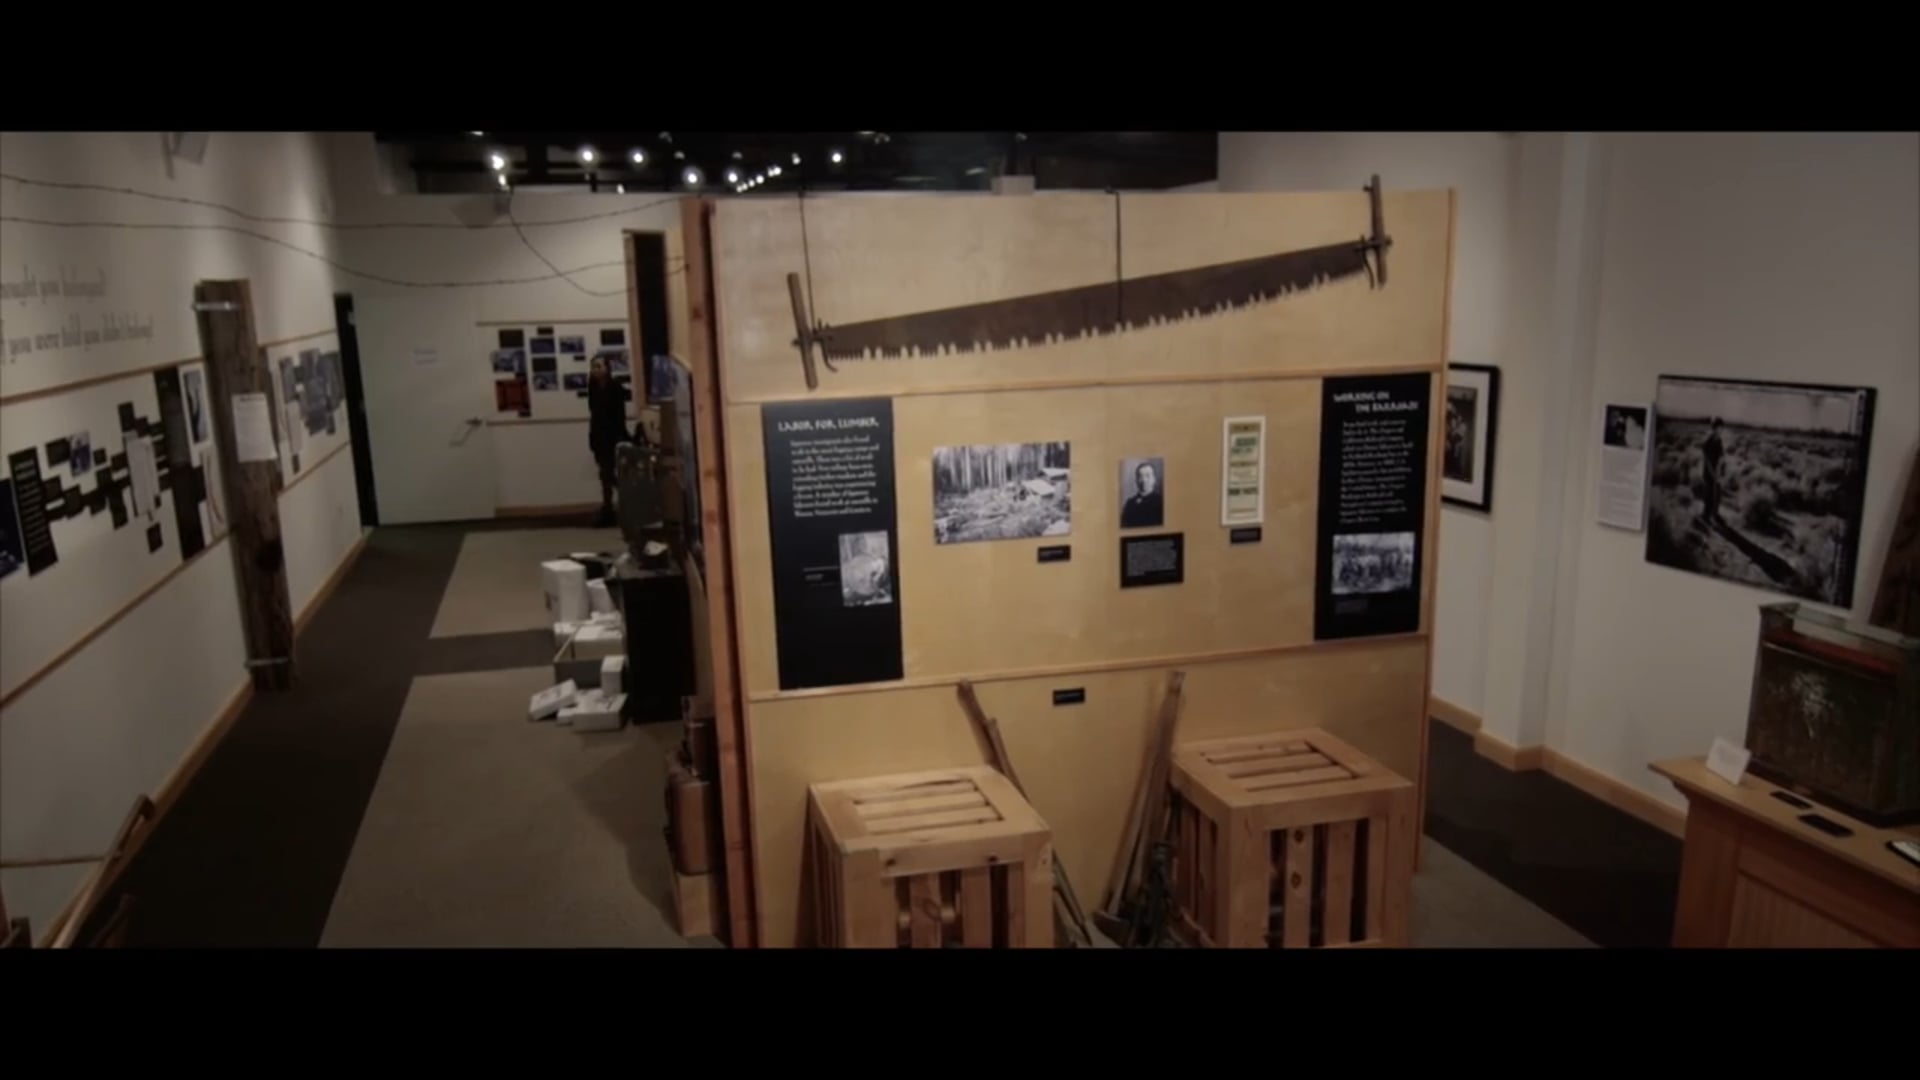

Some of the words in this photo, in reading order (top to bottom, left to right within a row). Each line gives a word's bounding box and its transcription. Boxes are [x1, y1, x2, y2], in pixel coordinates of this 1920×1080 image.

[1333, 391, 1375, 403] WORKING
[1376, 391, 1390, 400] ON
[777, 420, 814, 432] LABOR
[815, 418, 837, 430] FOR
[837, 416, 880, 429] LUMBER
